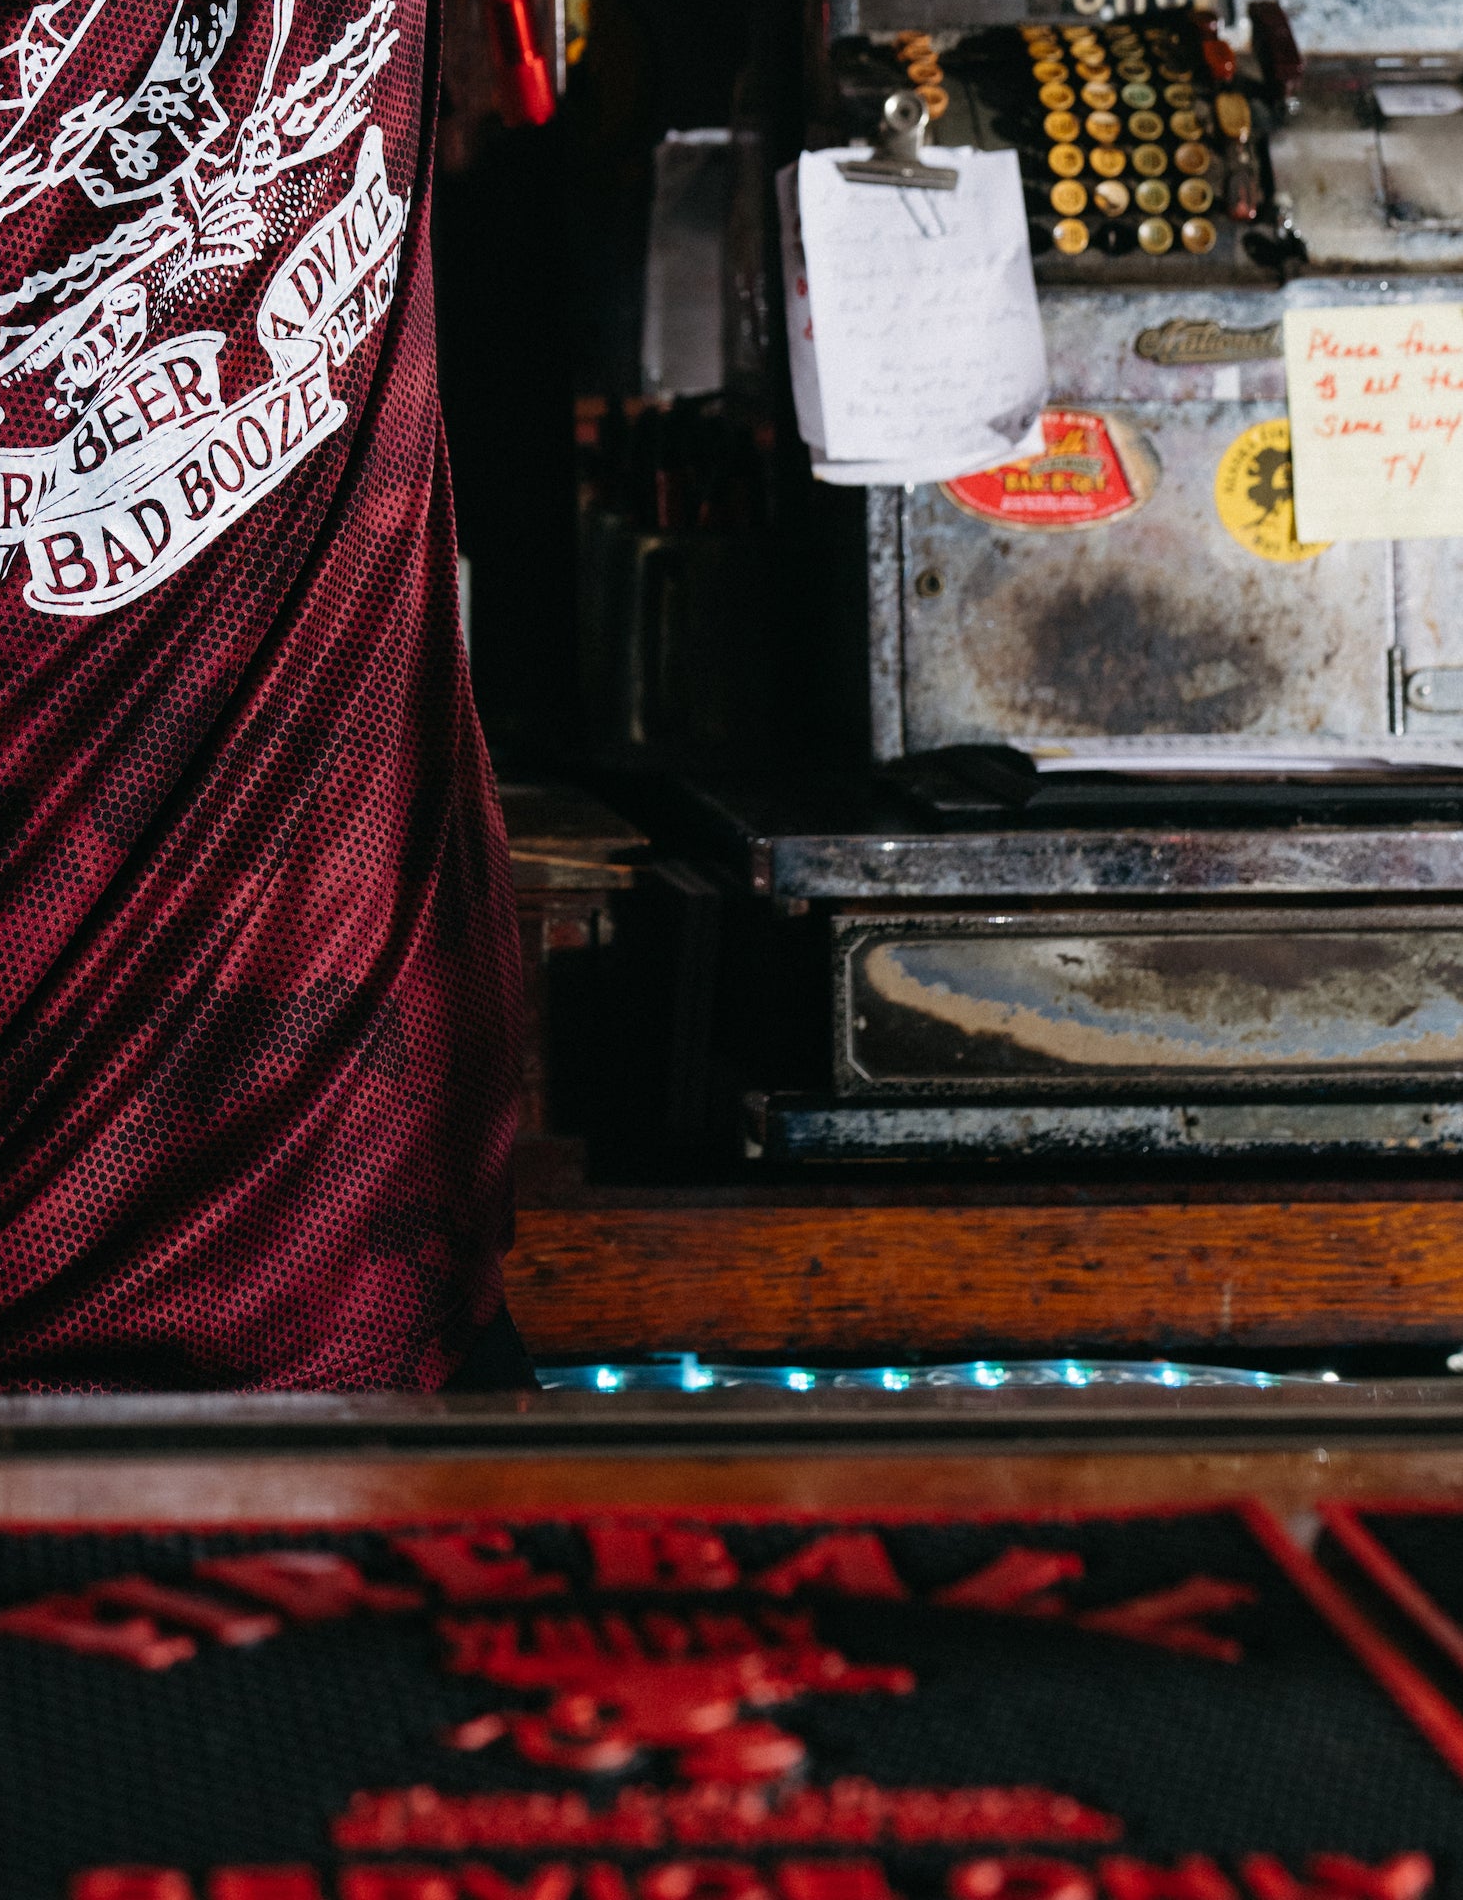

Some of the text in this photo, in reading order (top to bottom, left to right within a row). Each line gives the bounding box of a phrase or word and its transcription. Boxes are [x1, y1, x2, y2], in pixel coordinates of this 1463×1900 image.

[270, 173, 393, 340] ADVICE
[38, 376, 333, 594] BAD BOOZE
[69, 354, 218, 475] BEER
[1382, 452, 1426, 487] TY
